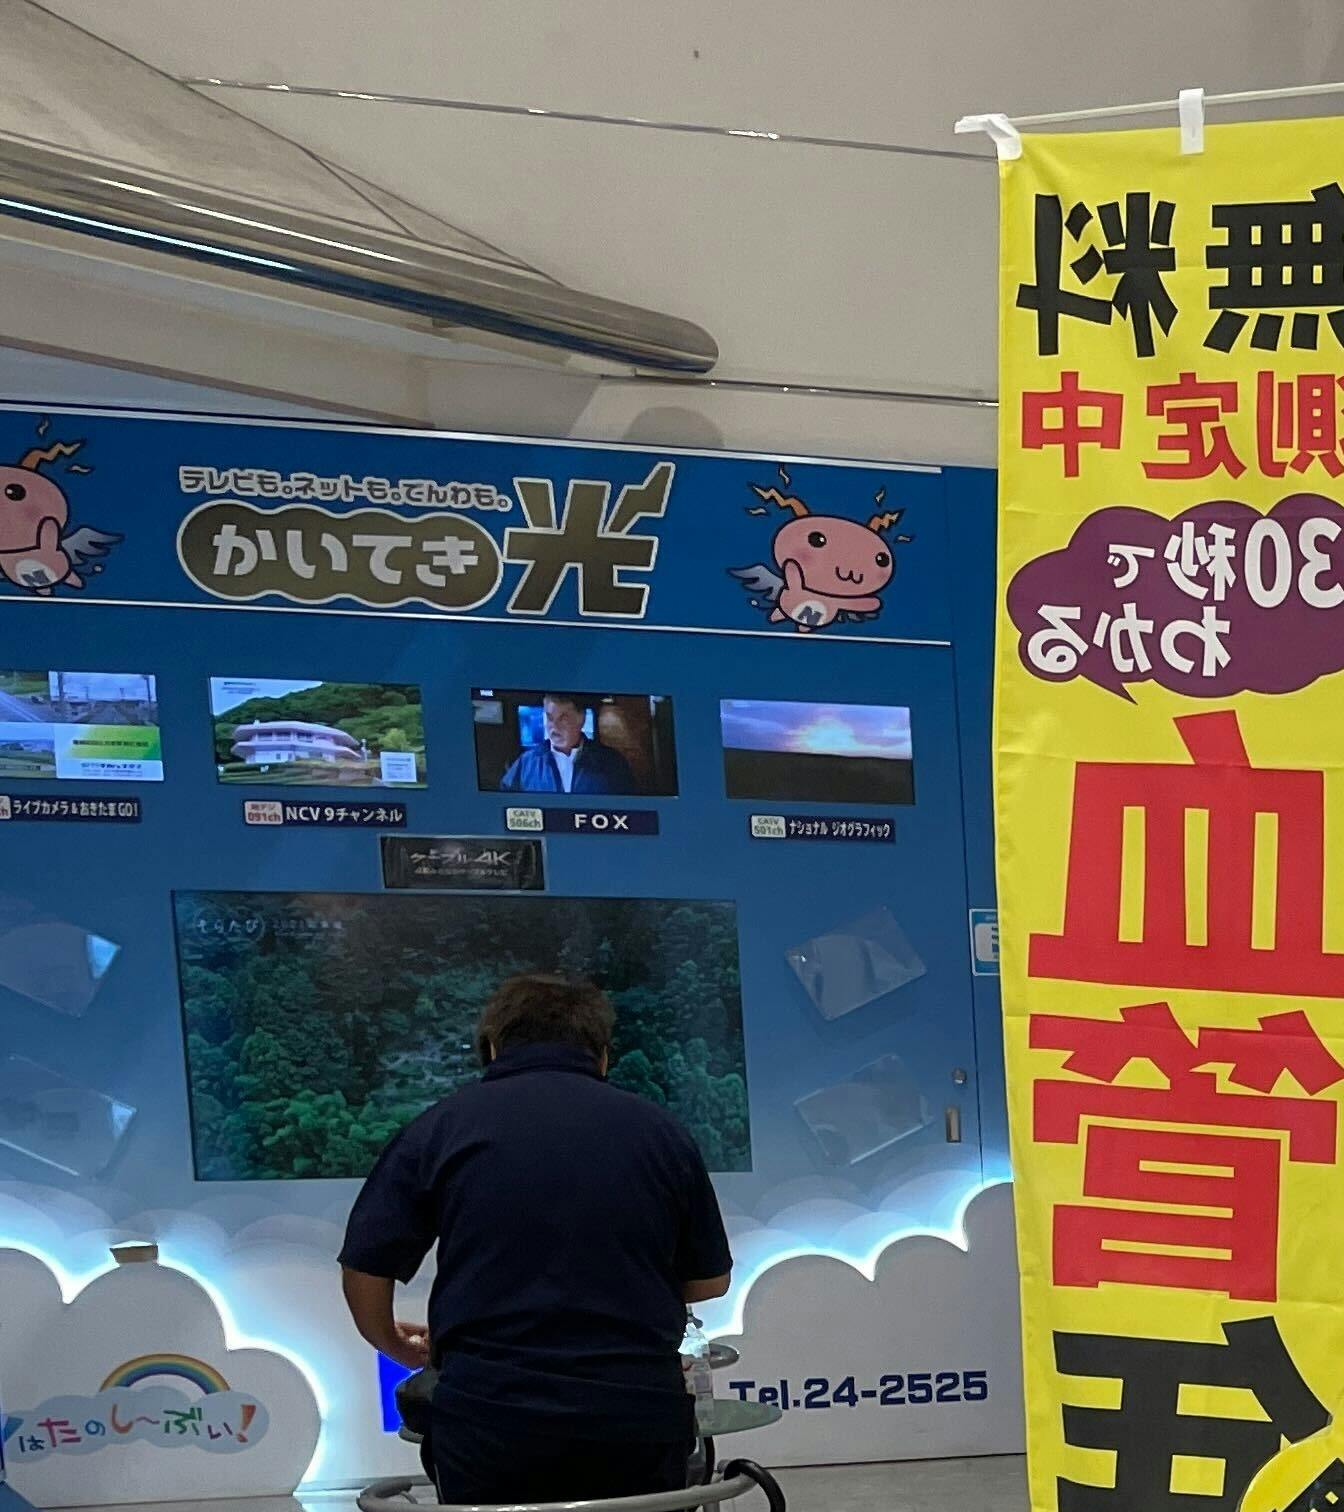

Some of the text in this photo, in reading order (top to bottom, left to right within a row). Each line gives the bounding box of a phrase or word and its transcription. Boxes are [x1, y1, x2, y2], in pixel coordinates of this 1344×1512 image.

[180, 466, 512, 511] テレビも。ネットも。でんわも。
[286, 806, 321, 822] NCV
[573, 813, 630, 831] FOX
[729, 1370, 988, 1410] Tel.24-2525
